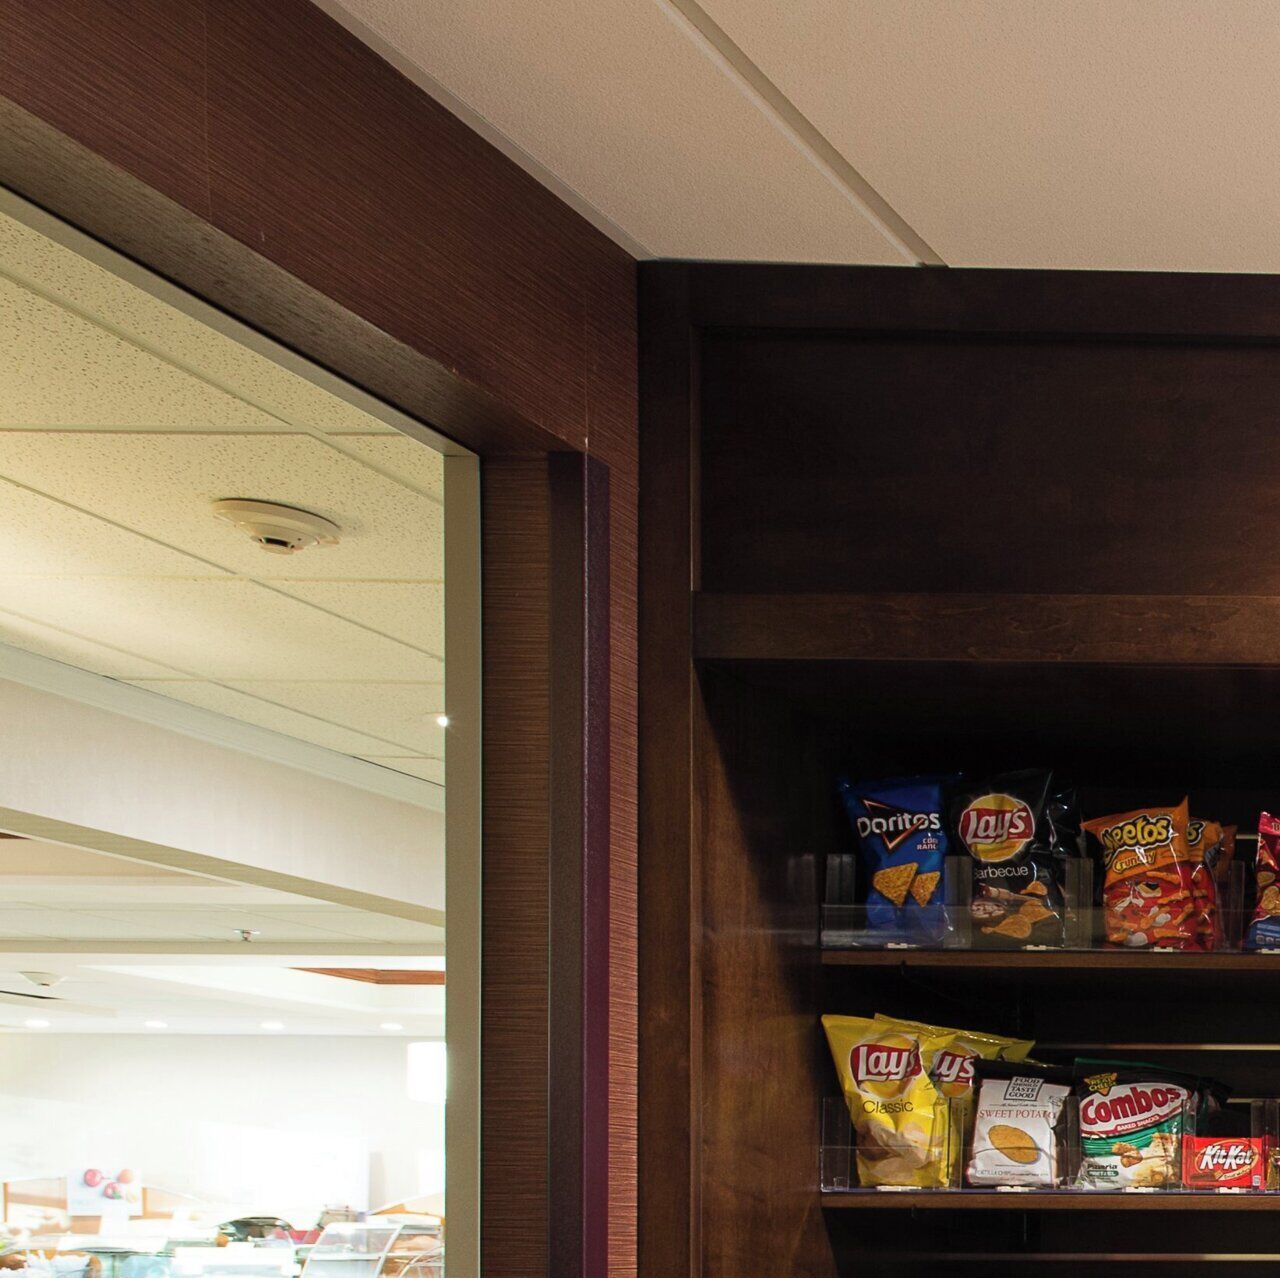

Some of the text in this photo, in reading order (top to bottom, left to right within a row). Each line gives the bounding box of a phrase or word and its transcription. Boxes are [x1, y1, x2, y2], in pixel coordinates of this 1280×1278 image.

[857, 812, 941, 838] Doritos
[966, 808, 1028, 845] Lay's
[973, 864, 1029, 879] arbecue
[862, 1100, 914, 1114] Classic
[979, 1109, 1014, 1118] SWEET
[1081, 1087, 1181, 1126] Combos
[1116, 1115, 1160, 1132] BAKED SNACKS
